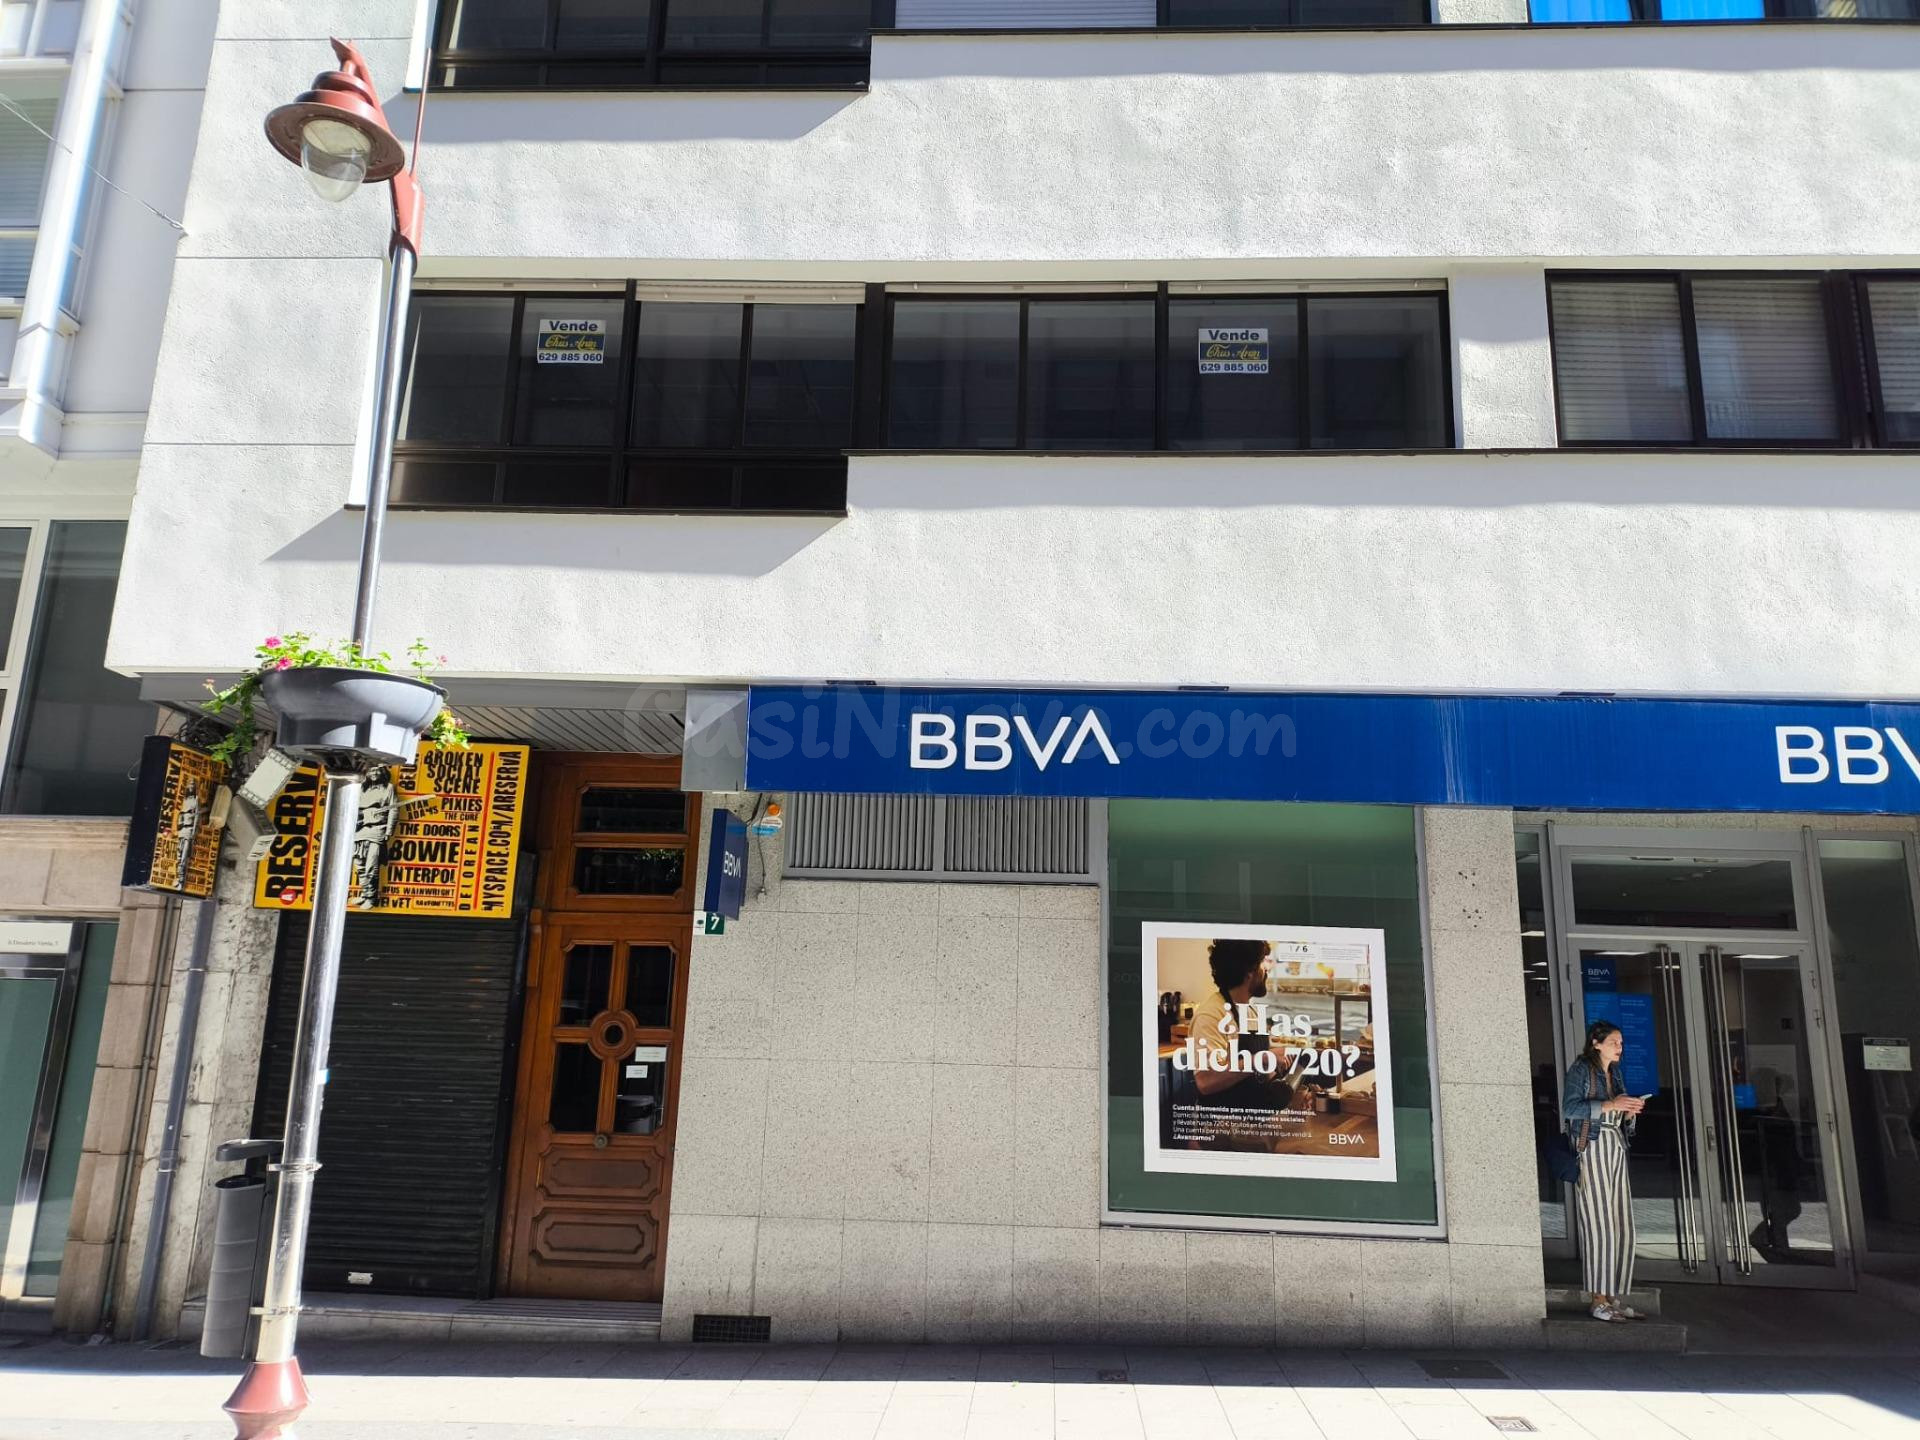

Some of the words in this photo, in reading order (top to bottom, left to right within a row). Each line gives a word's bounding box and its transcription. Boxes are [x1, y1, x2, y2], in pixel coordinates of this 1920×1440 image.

[549, 321, 598, 332] Vende
[1208, 330, 1260, 341] Vende
[539, 353, 558, 361] 629
[561, 353, 580, 361] 885
[582, 354, 602, 362] 060
[1200, 364, 1220, 372] 629
[1224, 364, 1244, 372] 885
[1247, 364, 1267, 372] 060
[910, 709, 1120, 772] BBVA
[424, 750, 483, 767] BROKEN
[427, 764, 480, 779] SOCIAL
[434, 776, 480, 794] SCENE
[405, 799, 430, 812] RYAN
[441, 797, 482, 812] PIXIES
[444, 812, 458, 821] THE
[459, 813, 478, 822] CURE
[265, 760, 321, 899] RESERV
[400, 823, 420, 835] THE
[423, 824, 461, 838] DOORS
[481, 751, 522, 912] MYSPACE.COM/ARESERVA
[390, 840, 459, 864] BOWIE
[458, 824, 480, 911] DELOREAN
[723, 850, 742, 878] BBVA
[388, 866, 456, 883] INTERPOL
[403, 887, 455, 896] WAINWRIGHT
[710, 916, 720, 930] 7
[1218, 1003, 1312, 1037] ¿Has
[1173, 1038, 1276, 1074] dicho
[1284, 1044, 1360, 1077] 720?
[1210, 1114, 1242, 1122] impuestos
[1172, 1134, 1216, 1142] ¿Avanzamos?
[1260, 1130, 1273, 1138] para
[1328, 1134, 1364, 1144] BBVA
